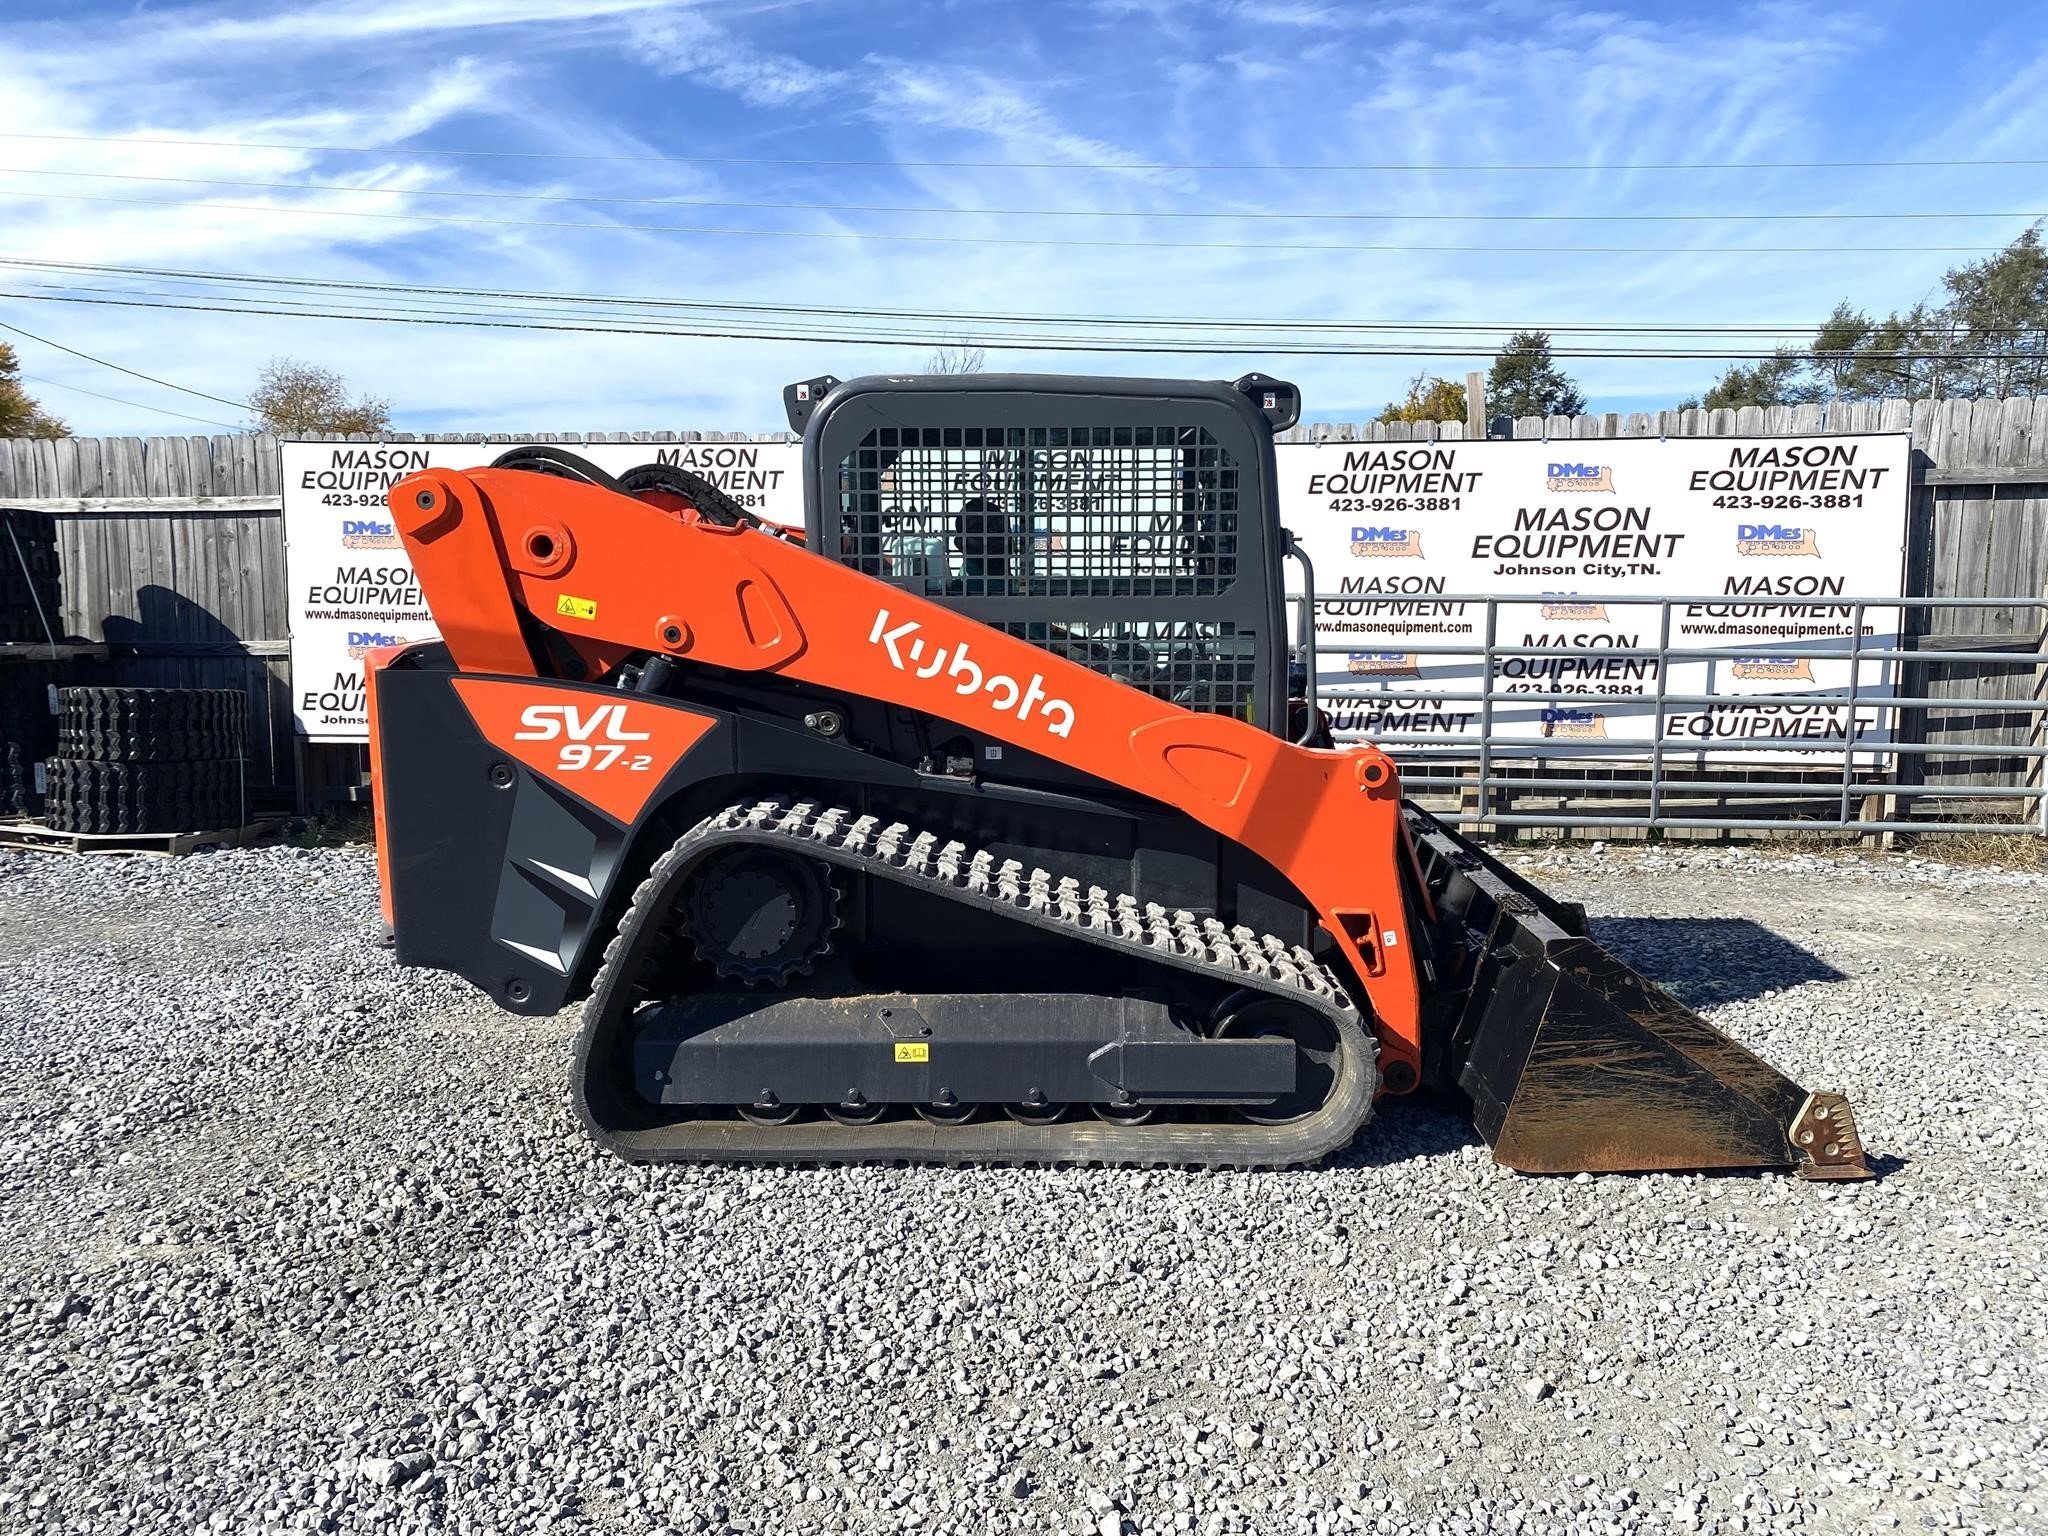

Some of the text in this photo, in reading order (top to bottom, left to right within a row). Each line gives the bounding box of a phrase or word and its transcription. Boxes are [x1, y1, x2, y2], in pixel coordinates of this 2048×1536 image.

[331, 450, 430, 469] MASON
[656, 448, 758, 468] MASON
[1343, 450, 1456, 471] MASON
[1728, 445, 1858, 468] MASON
[301, 471, 409, 490] EQUIPM
[1308, 472, 1483, 494] EQUIPMENT
[1689, 468, 1889, 491] EQUIPMENT
[321, 494, 390, 506] 423-926
[1329, 497, 1460, 511] 423-926-3881
[1712, 494, 1863, 508] 423-926-3881
[1514, 507, 1651, 531] MASON
[1471, 534, 1685, 558] EQUIPMENT
[1493, 564, 1576, 575] Johnson
[1340, 576, 1446, 594] MASON
[1723, 576, 1844, 596] MASON
[308, 587, 423, 605] EQUIPME
[305, 609, 432, 623] www.dmasonequipment.
[1681, 622, 1874, 638] www.dmasonequipment.cm
[868, 608, 1076, 739] Kubota
[320, 715, 369, 724] Johns
[513, 705, 650, 741] SVL
[1666, 715, 1874, 739] EQUIPMENT
[556, 744, 652, 771] 97-2
